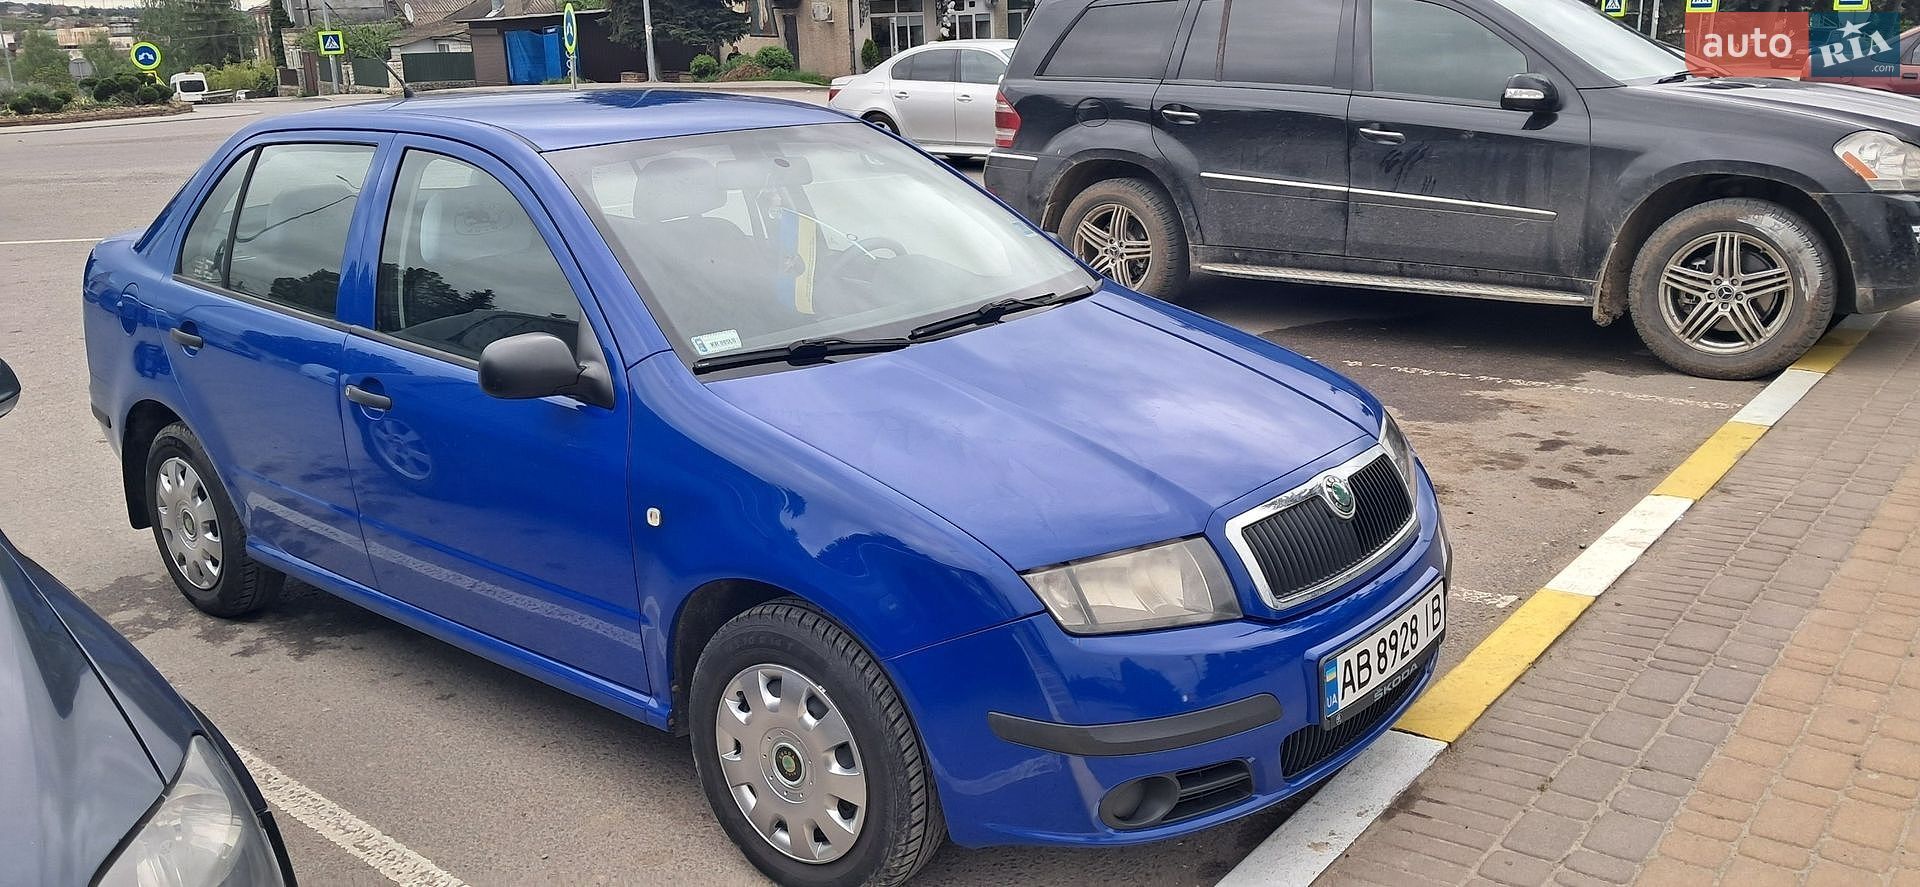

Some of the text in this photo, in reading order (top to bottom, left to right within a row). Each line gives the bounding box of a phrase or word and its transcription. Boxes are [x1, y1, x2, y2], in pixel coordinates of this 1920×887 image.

[1341, 593, 1442, 701] AB 8928 IB
[1326, 693, 1338, 708] UA
